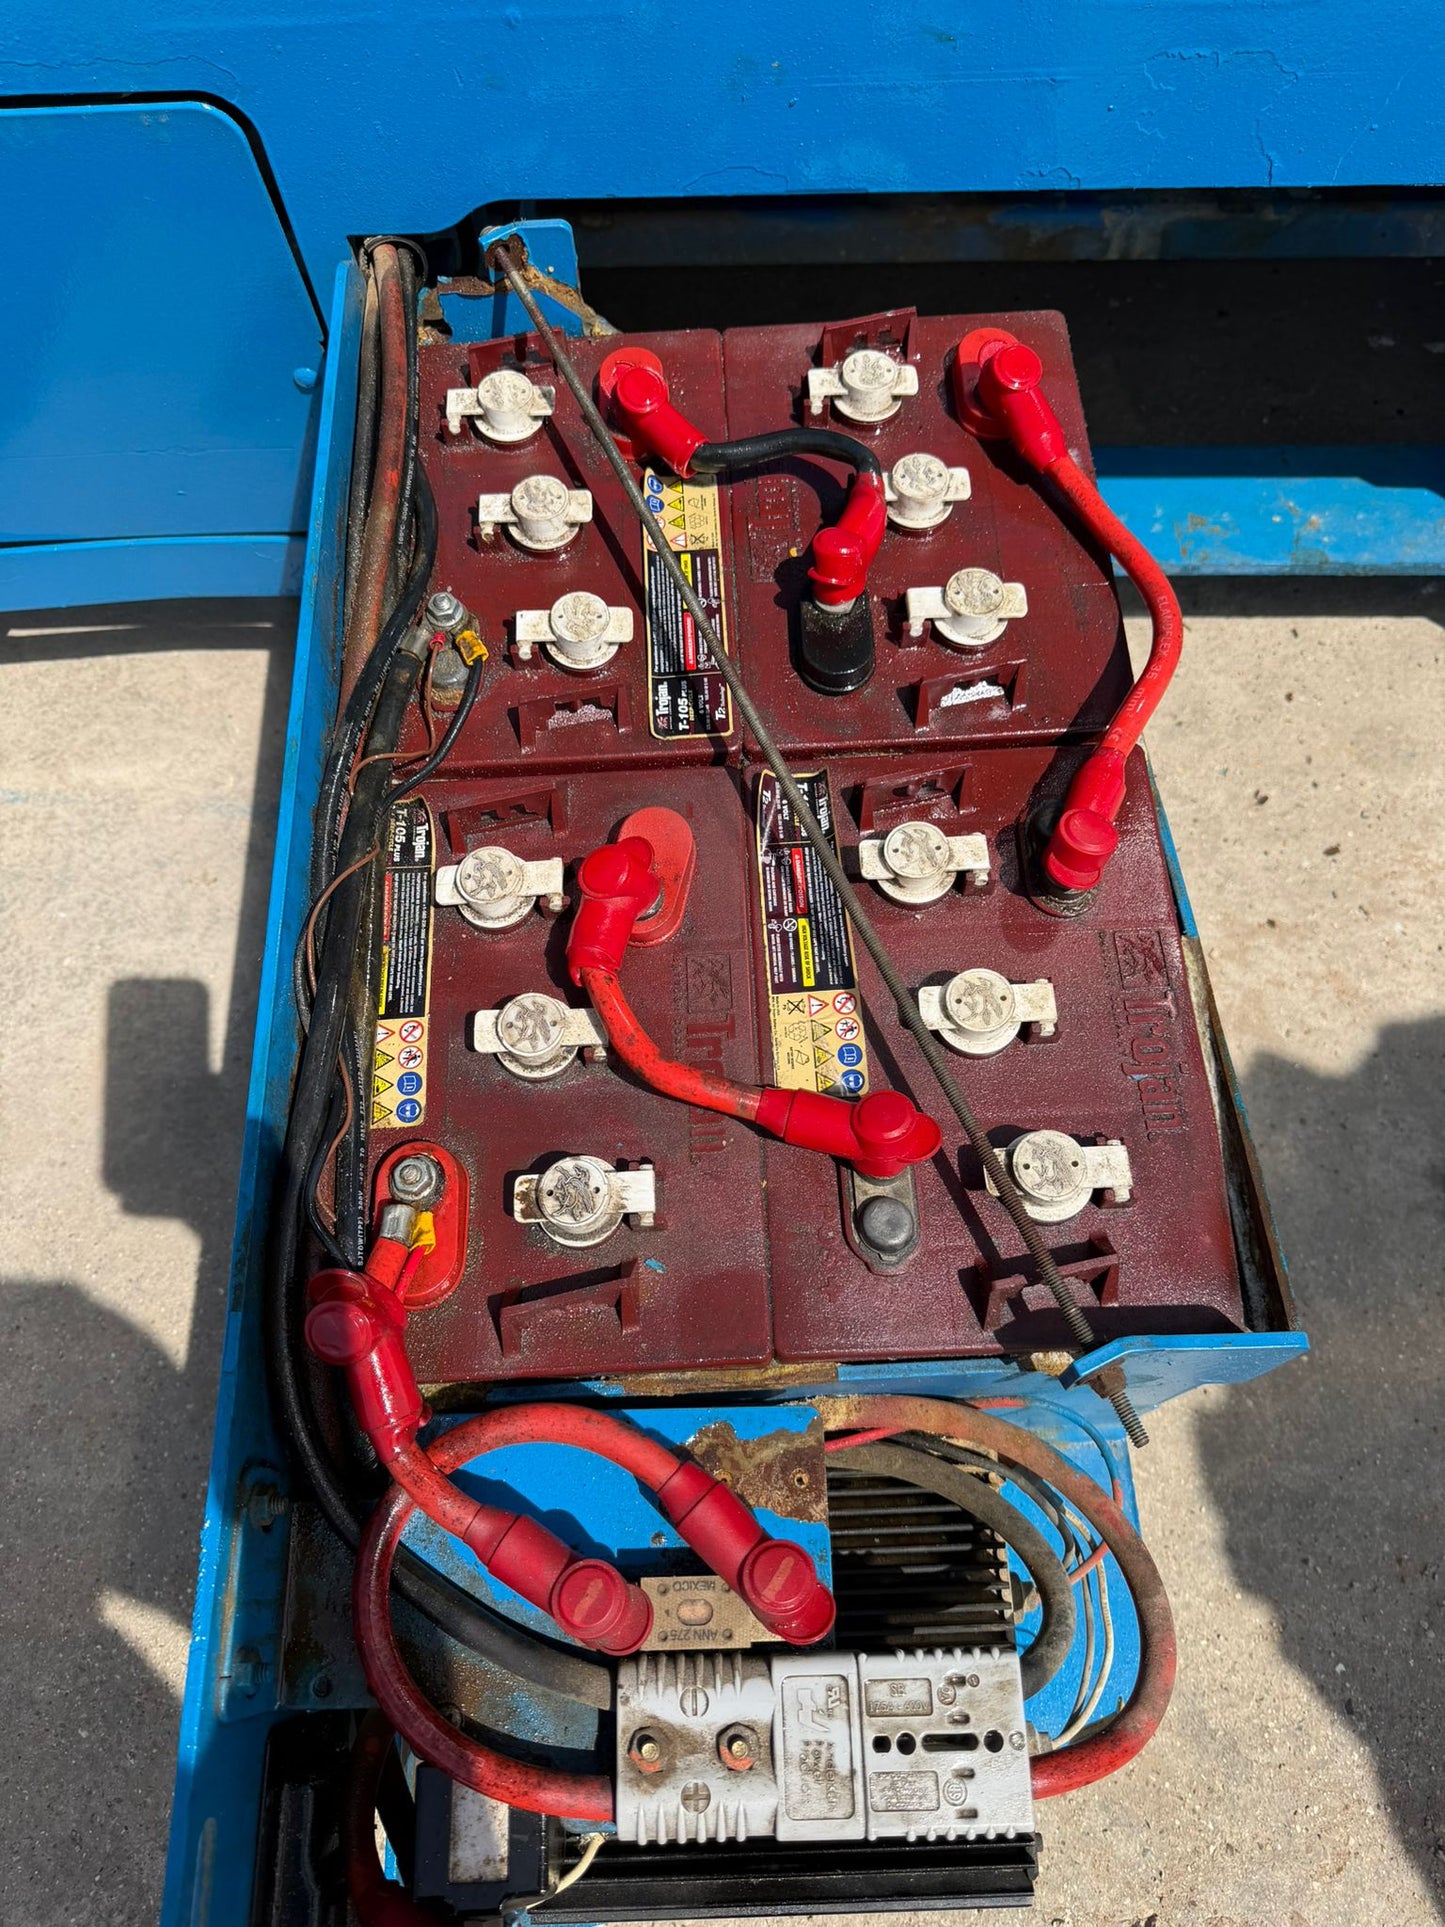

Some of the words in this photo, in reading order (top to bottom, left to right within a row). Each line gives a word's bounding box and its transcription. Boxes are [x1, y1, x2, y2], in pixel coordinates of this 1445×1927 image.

[1146, 664, 1162, 680] 35
[678, 698, 689, 730] T-105
[395, 808, 408, 843] T-105
[1121, 990, 1190, 1135] Trojan
[687, 1014, 737, 1153] Troan
[673, 1581, 715, 1591] MEXICO
[670, 1629, 691, 1640] 275
[693, 1629, 718, 1640] ANN
